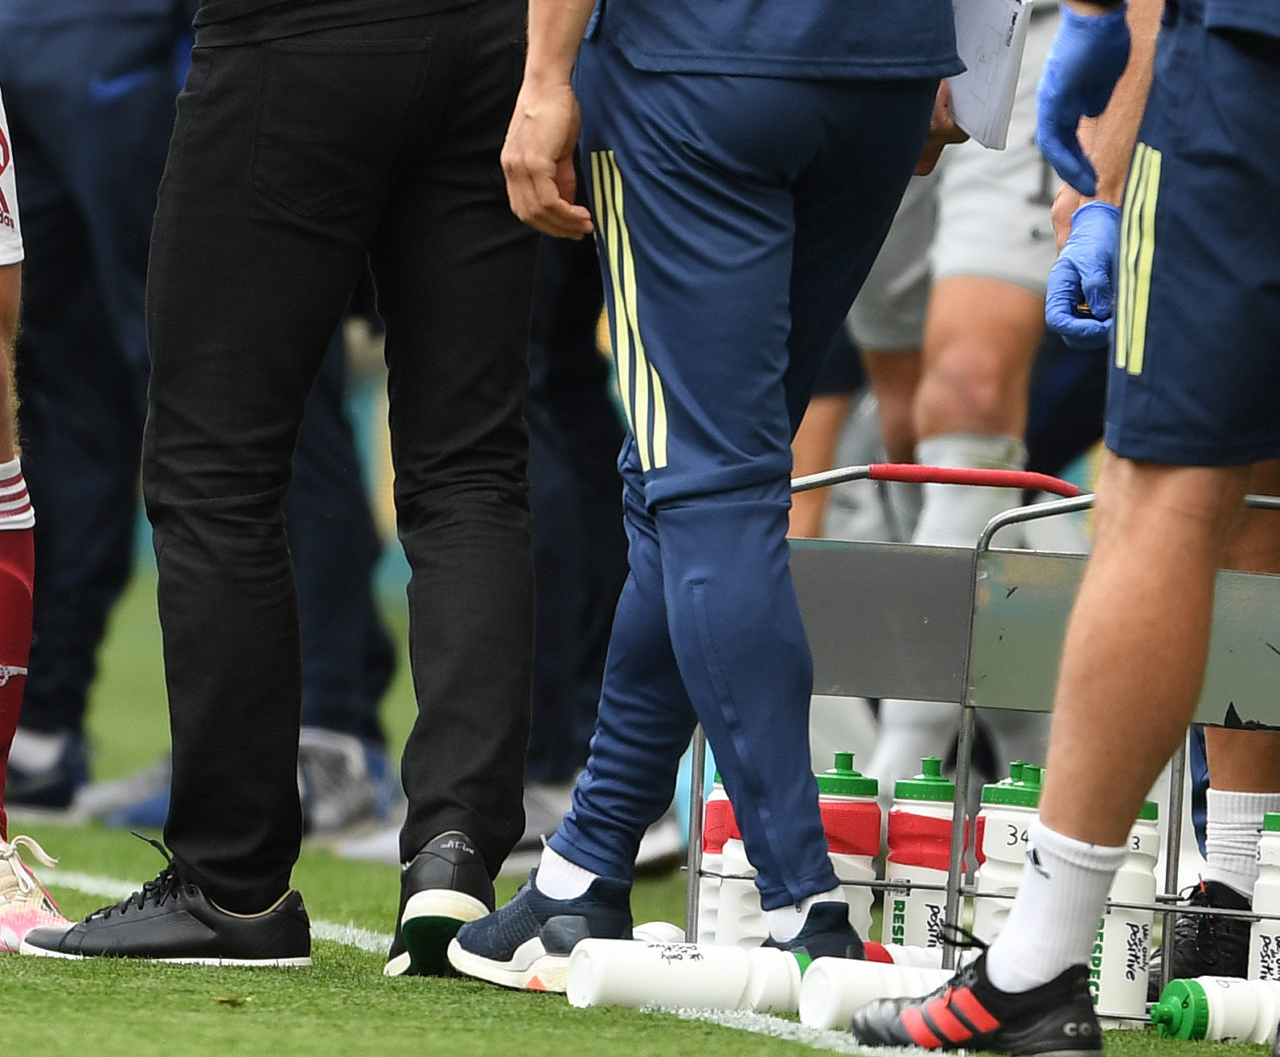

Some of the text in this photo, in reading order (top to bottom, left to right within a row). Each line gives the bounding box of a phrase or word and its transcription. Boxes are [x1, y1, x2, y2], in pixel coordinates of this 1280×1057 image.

[1007, 824, 1029, 846] 34
[1131, 835, 1141, 851] 3
[1125, 922, 1141, 982] positive
[1259, 934, 1274, 981] positiv
